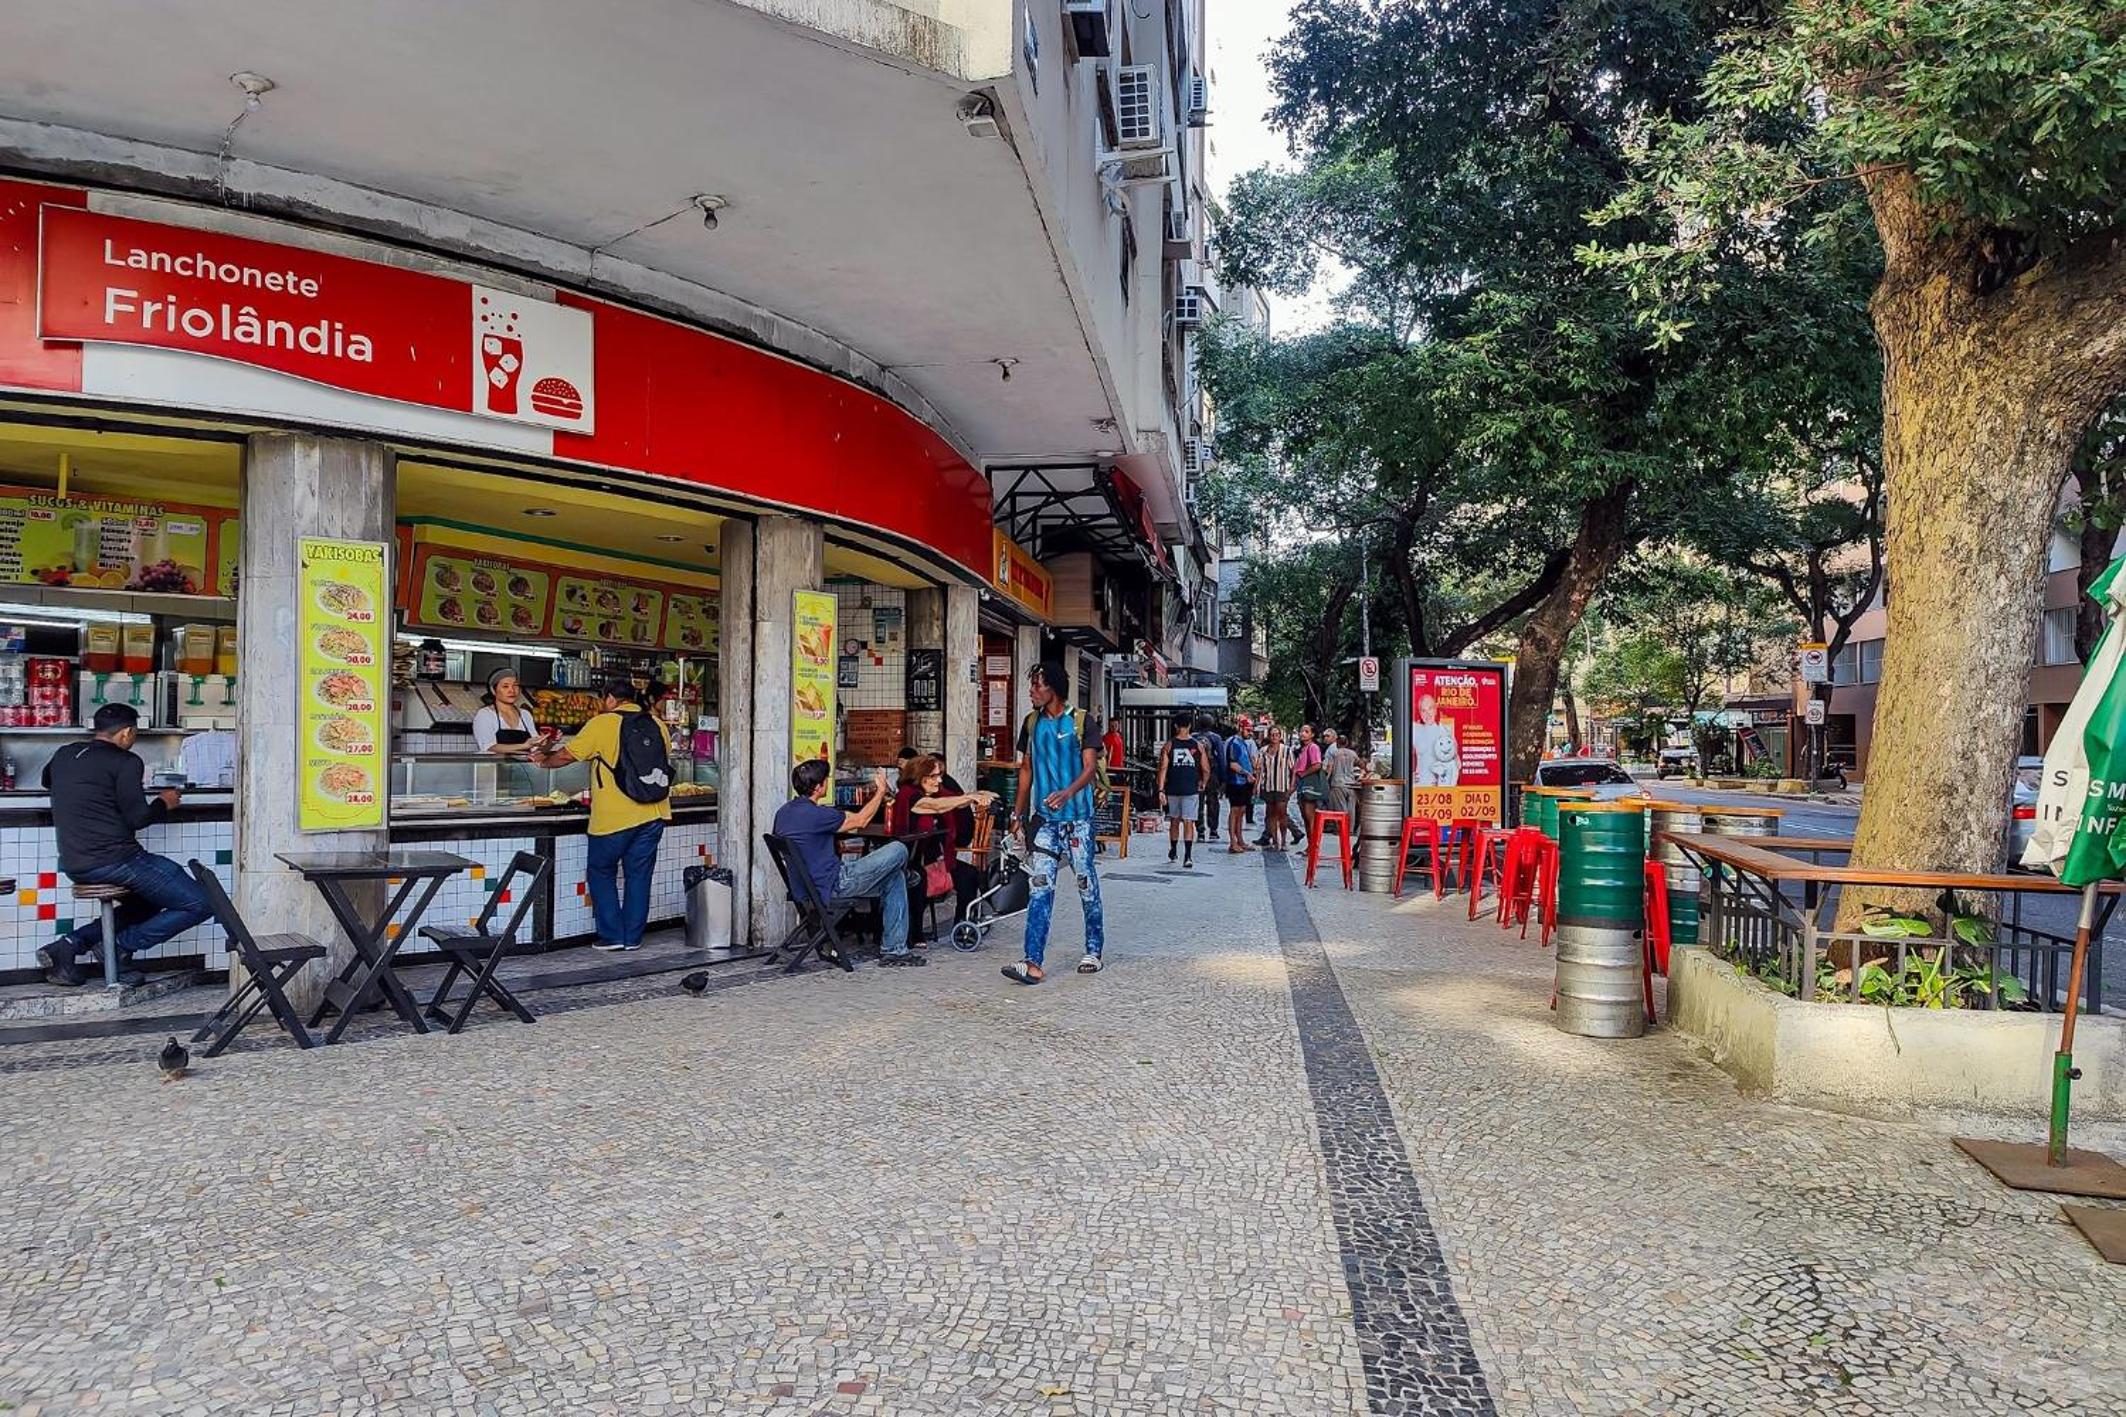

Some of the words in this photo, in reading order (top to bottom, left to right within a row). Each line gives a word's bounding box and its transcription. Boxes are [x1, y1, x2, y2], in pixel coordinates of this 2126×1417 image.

[104, 238, 319, 298] Lanchonete
[104, 287, 373, 363] Friolândia
[29, 494, 73, 509] SUCOS
[92, 500, 165, 517] VITAMINAS
[305, 543, 381, 563] YAKISOBAS
[1417, 793, 1453, 805] 23/08
[1465, 793, 1482, 804] DIA
[1460, 806, 1497, 818] 02/09
